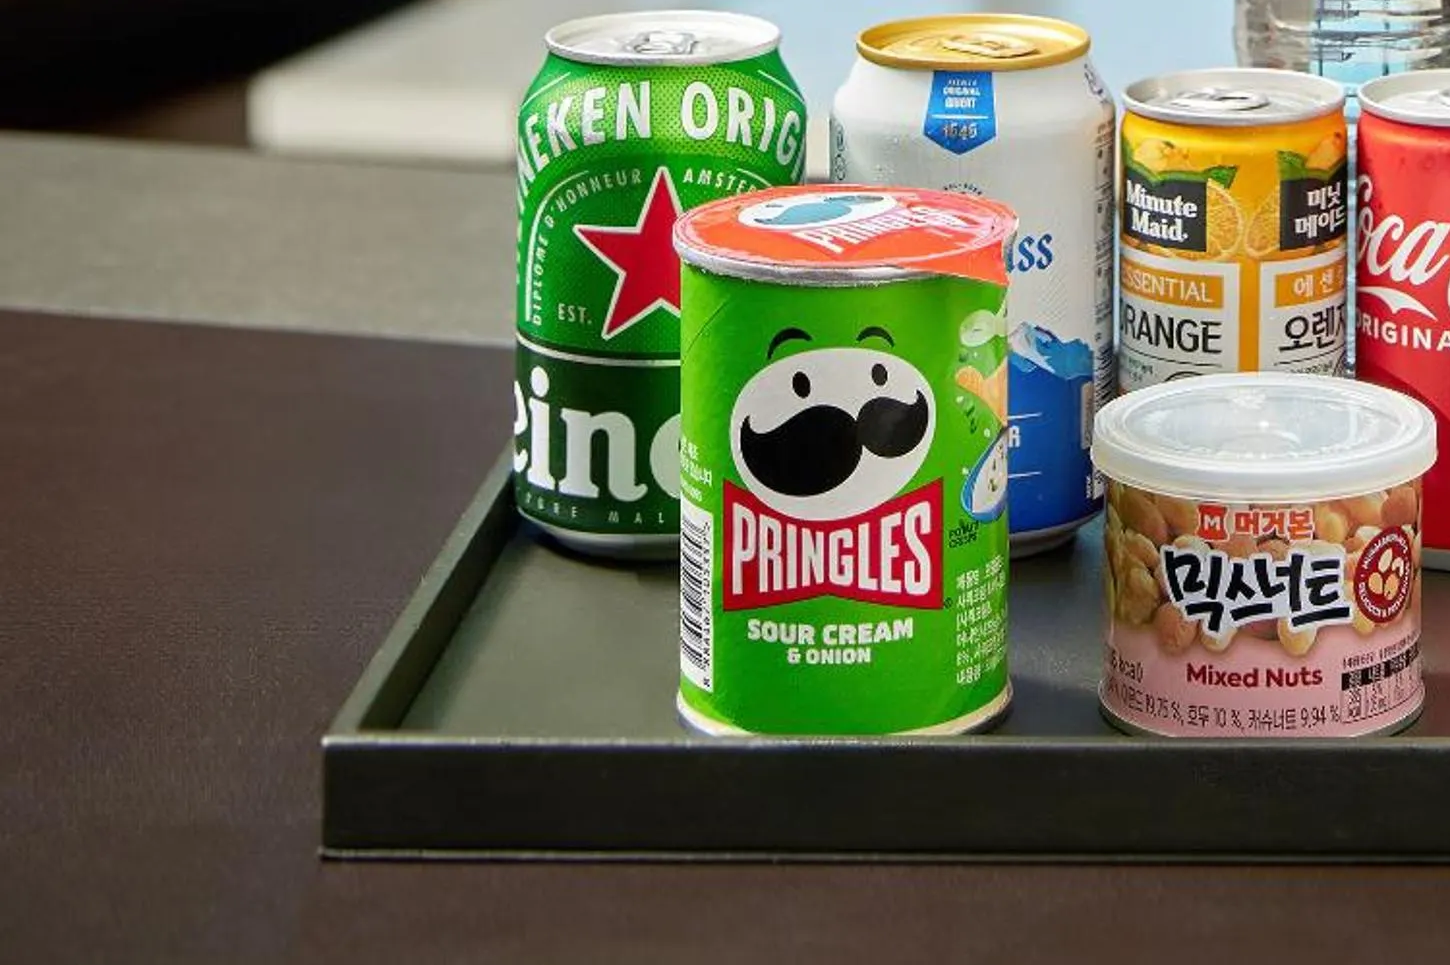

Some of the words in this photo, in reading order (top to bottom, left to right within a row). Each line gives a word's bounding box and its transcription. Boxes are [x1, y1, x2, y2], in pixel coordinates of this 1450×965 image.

[1126, 179, 1198, 218] Minute
[1306, 181, 1341, 210] 미닛
[1294, 204, 1345, 239] 메이드
[557, 303, 592, 325] EST.
[1121, 299, 1223, 354] RANGE
[608, 511, 665, 524] MAL
[1234, 510, 1313, 540] 머거본
[731, 500, 932, 596] PRINGLES
[1165, 551, 1350, 632] 믹스너트
[747, 618, 816, 644] SOUR
[822, 617, 914, 645] CREAM
[787, 649, 801, 664] &
[805, 648, 872, 664] ONION
[1186, 662, 1259, 687] Mixed
[1265, 666, 1323, 687] Nuts
[1187, 705, 1209, 728] 호두
[1213, 707, 1226, 728] 10
[1300, 705, 1327, 728] 9.94
